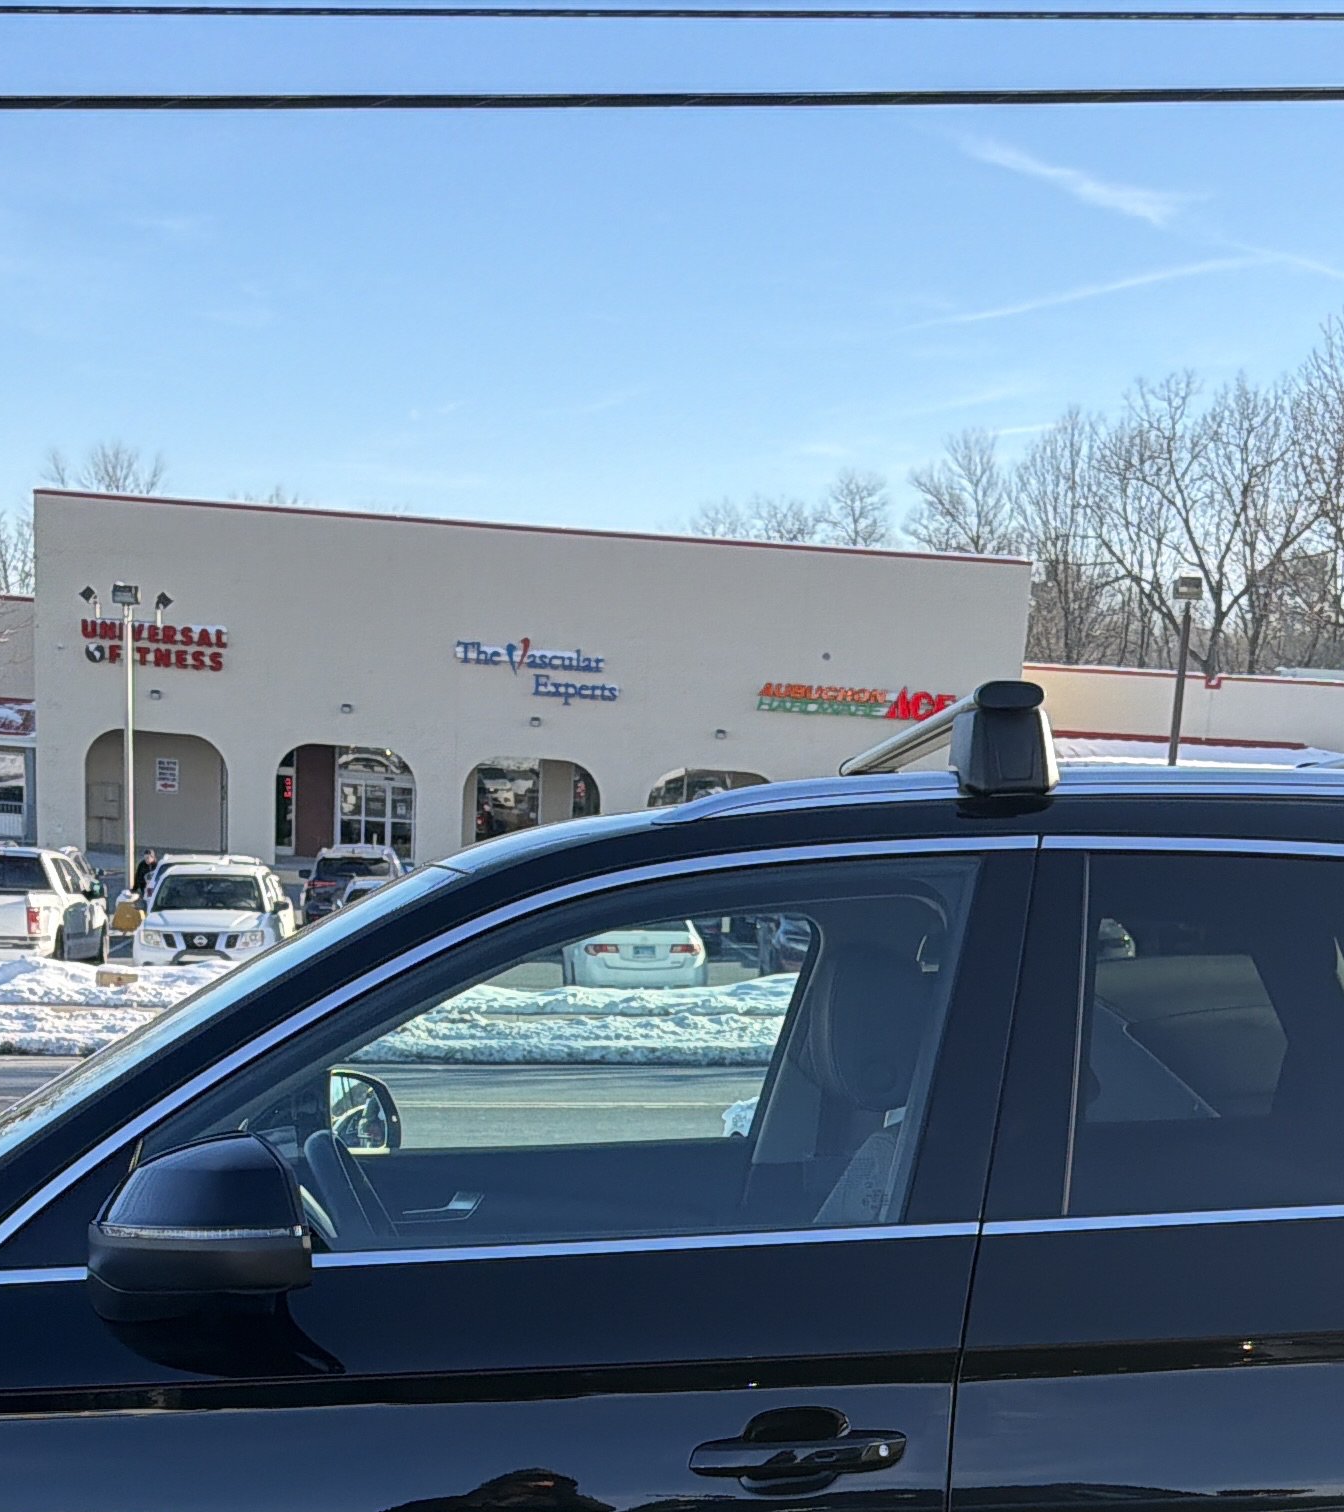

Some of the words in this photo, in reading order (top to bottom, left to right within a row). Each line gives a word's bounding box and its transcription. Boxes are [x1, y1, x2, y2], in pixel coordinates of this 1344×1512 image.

[80, 618, 228, 649] UNIVERSAL
[108, 644, 224, 672] FTNESS
[456, 640, 501, 665] The
[506, 637, 605, 676] Vascular
[532, 674, 619, 706] Experts
